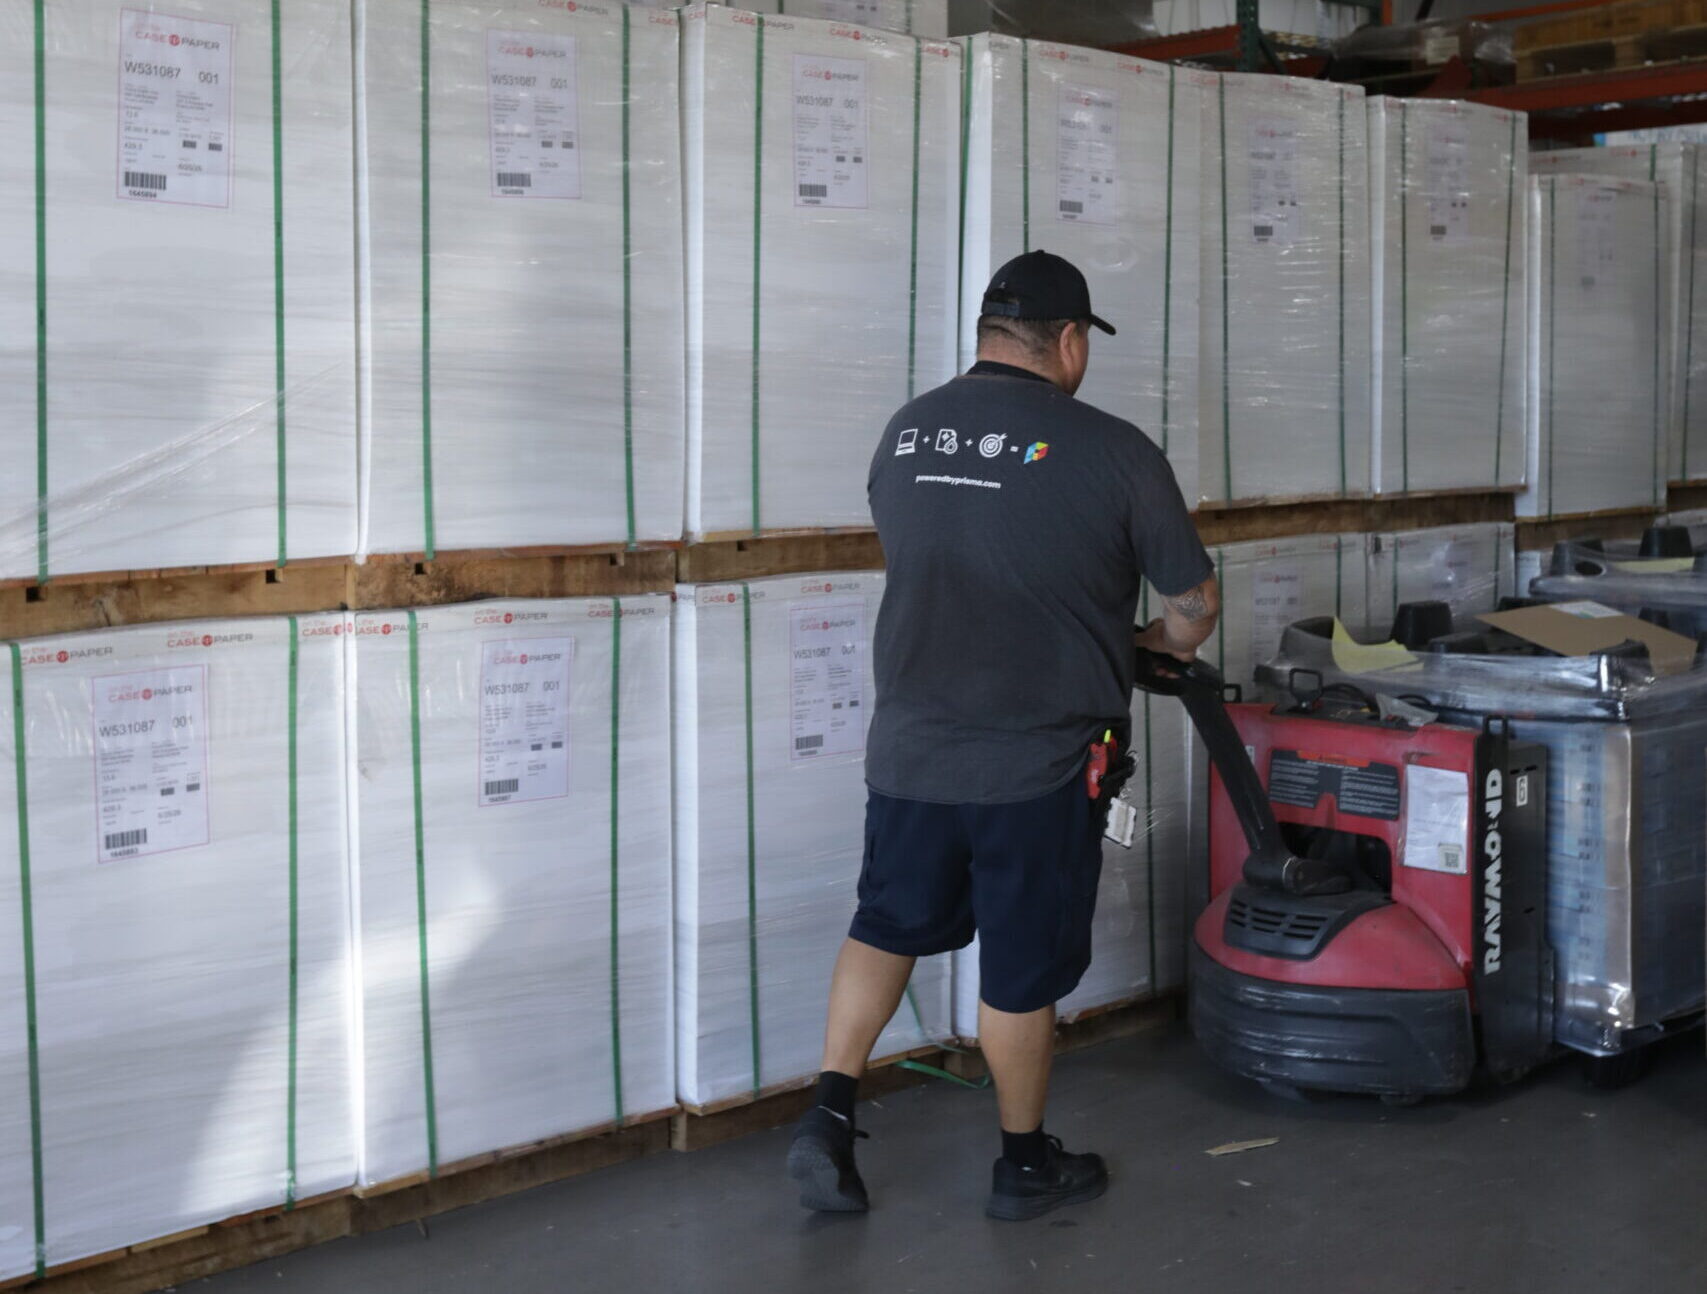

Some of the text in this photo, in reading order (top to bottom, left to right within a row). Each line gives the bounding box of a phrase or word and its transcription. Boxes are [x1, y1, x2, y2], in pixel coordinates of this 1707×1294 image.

[135, 30, 220, 51] CASE PAPER
[535, 48, 567, 58] PAPER
[124, 60, 219, 84] W531087 001
[491, 74, 568, 89] W531087 001
[474, 612, 549, 625] CASE PAPER
[392, 622, 429, 632] PAER
[167, 633, 254, 648] CASE PAPER
[70, 646, 113, 660] PAPER
[528, 653, 561, 663] PAPER
[108, 684, 193, 703] CASE PAPER
[484, 680, 561, 696] W531087 001
[98, 715, 194, 738] W531087 001
[1484, 768, 1503, 975] RAYMOND
